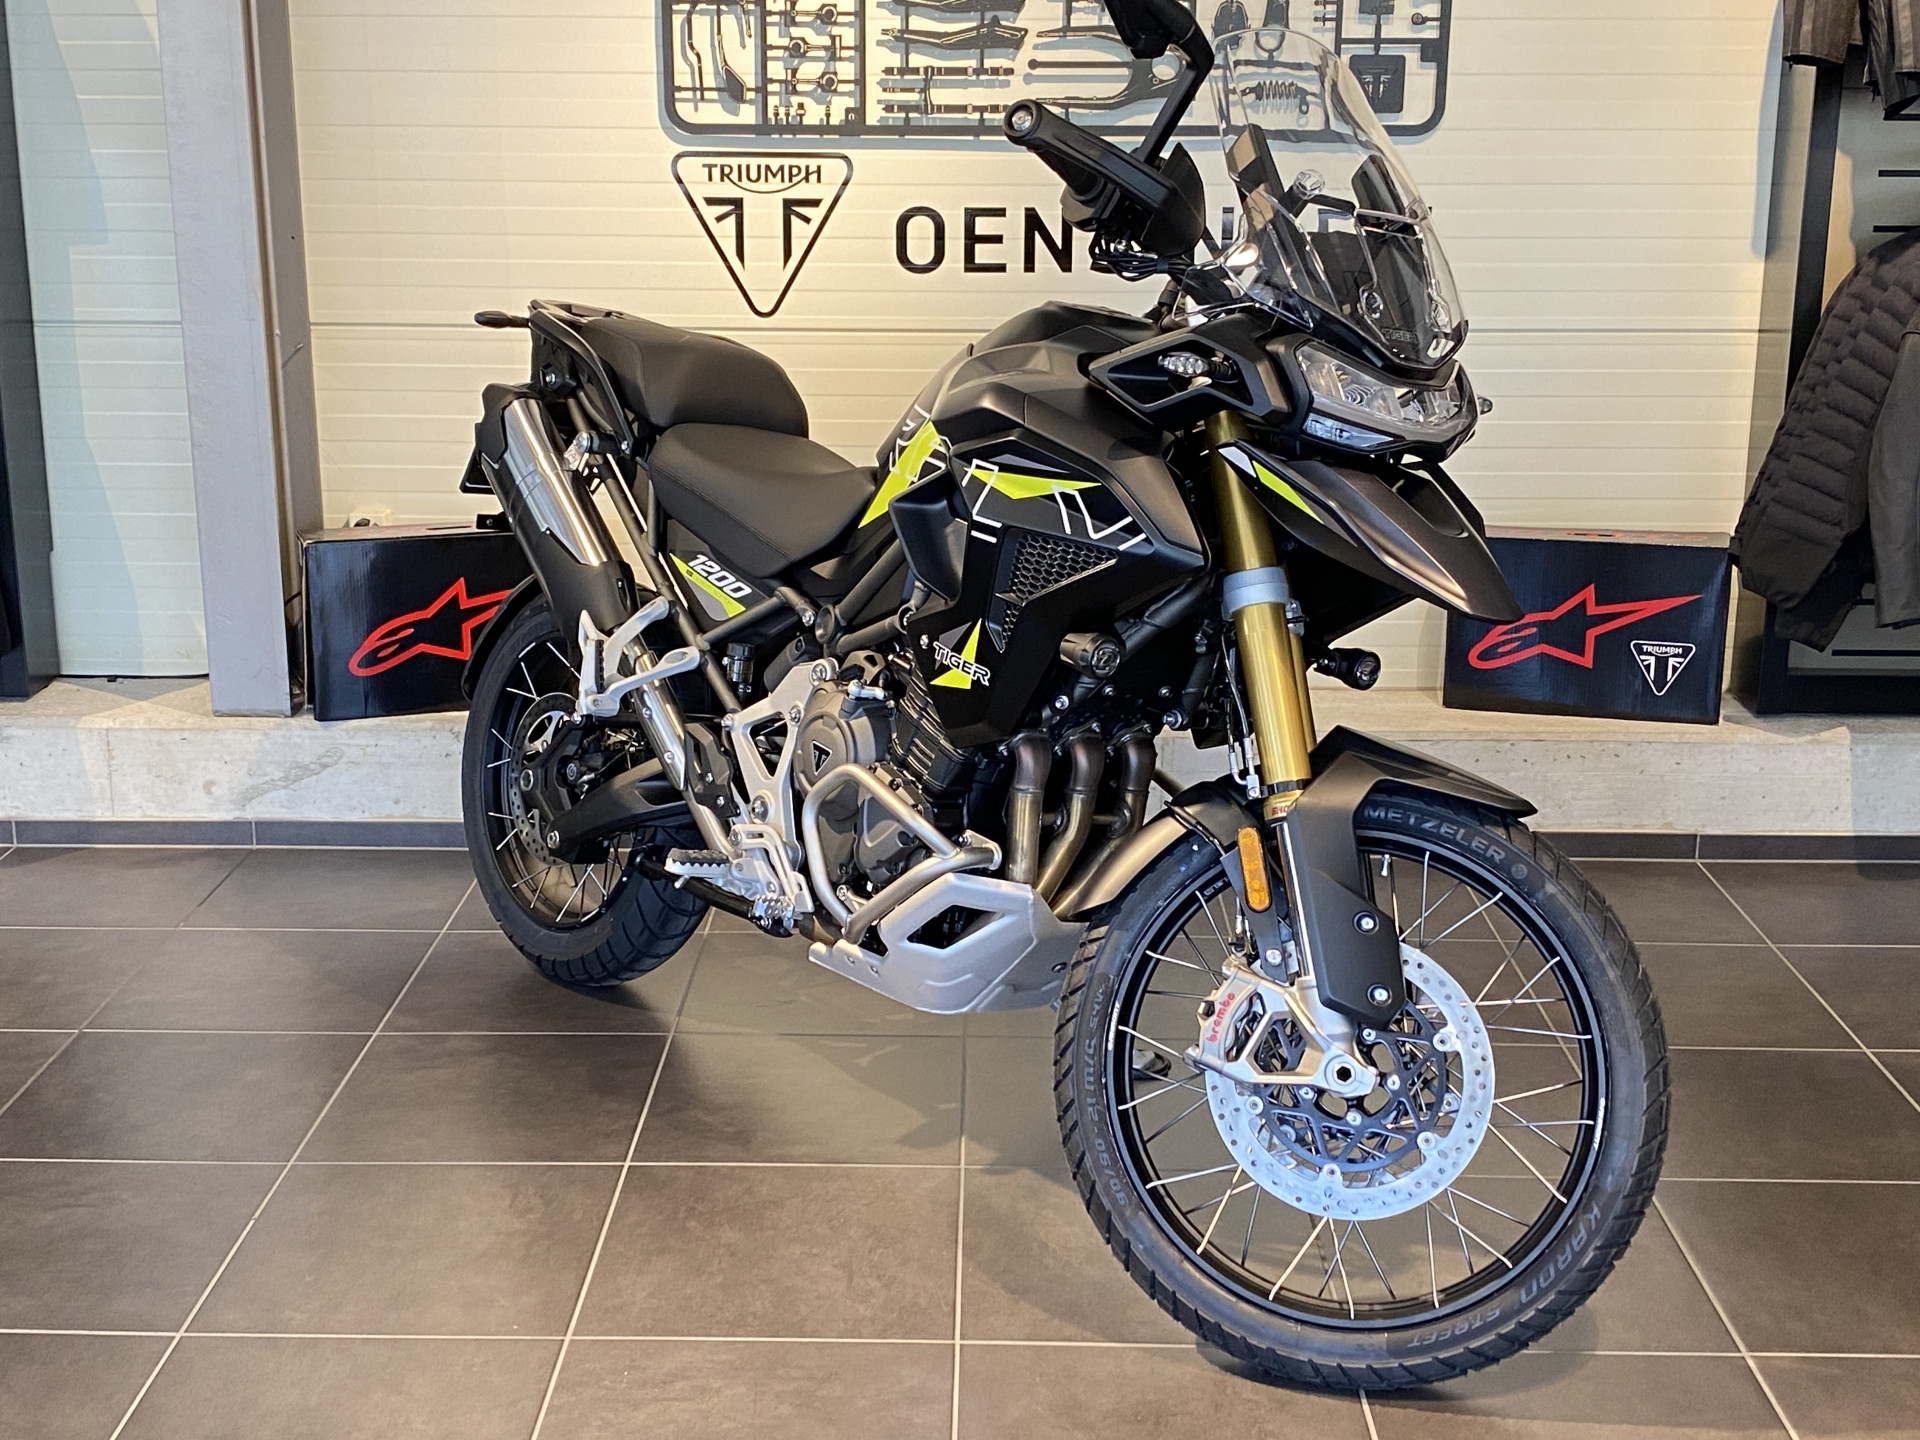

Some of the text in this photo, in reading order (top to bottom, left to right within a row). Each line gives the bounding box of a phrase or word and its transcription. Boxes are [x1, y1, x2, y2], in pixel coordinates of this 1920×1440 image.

[701, 163, 822, 189] TRIUMPH
[687, 554, 752, 599] 1200
[932, 641, 990, 687] TIGER
[1642, 644, 1683, 656] TRIUMPH
[1363, 805, 1507, 865] METZELER
[1205, 991, 1236, 1043] brembo
[1406, 1308, 1501, 1348] STREET
